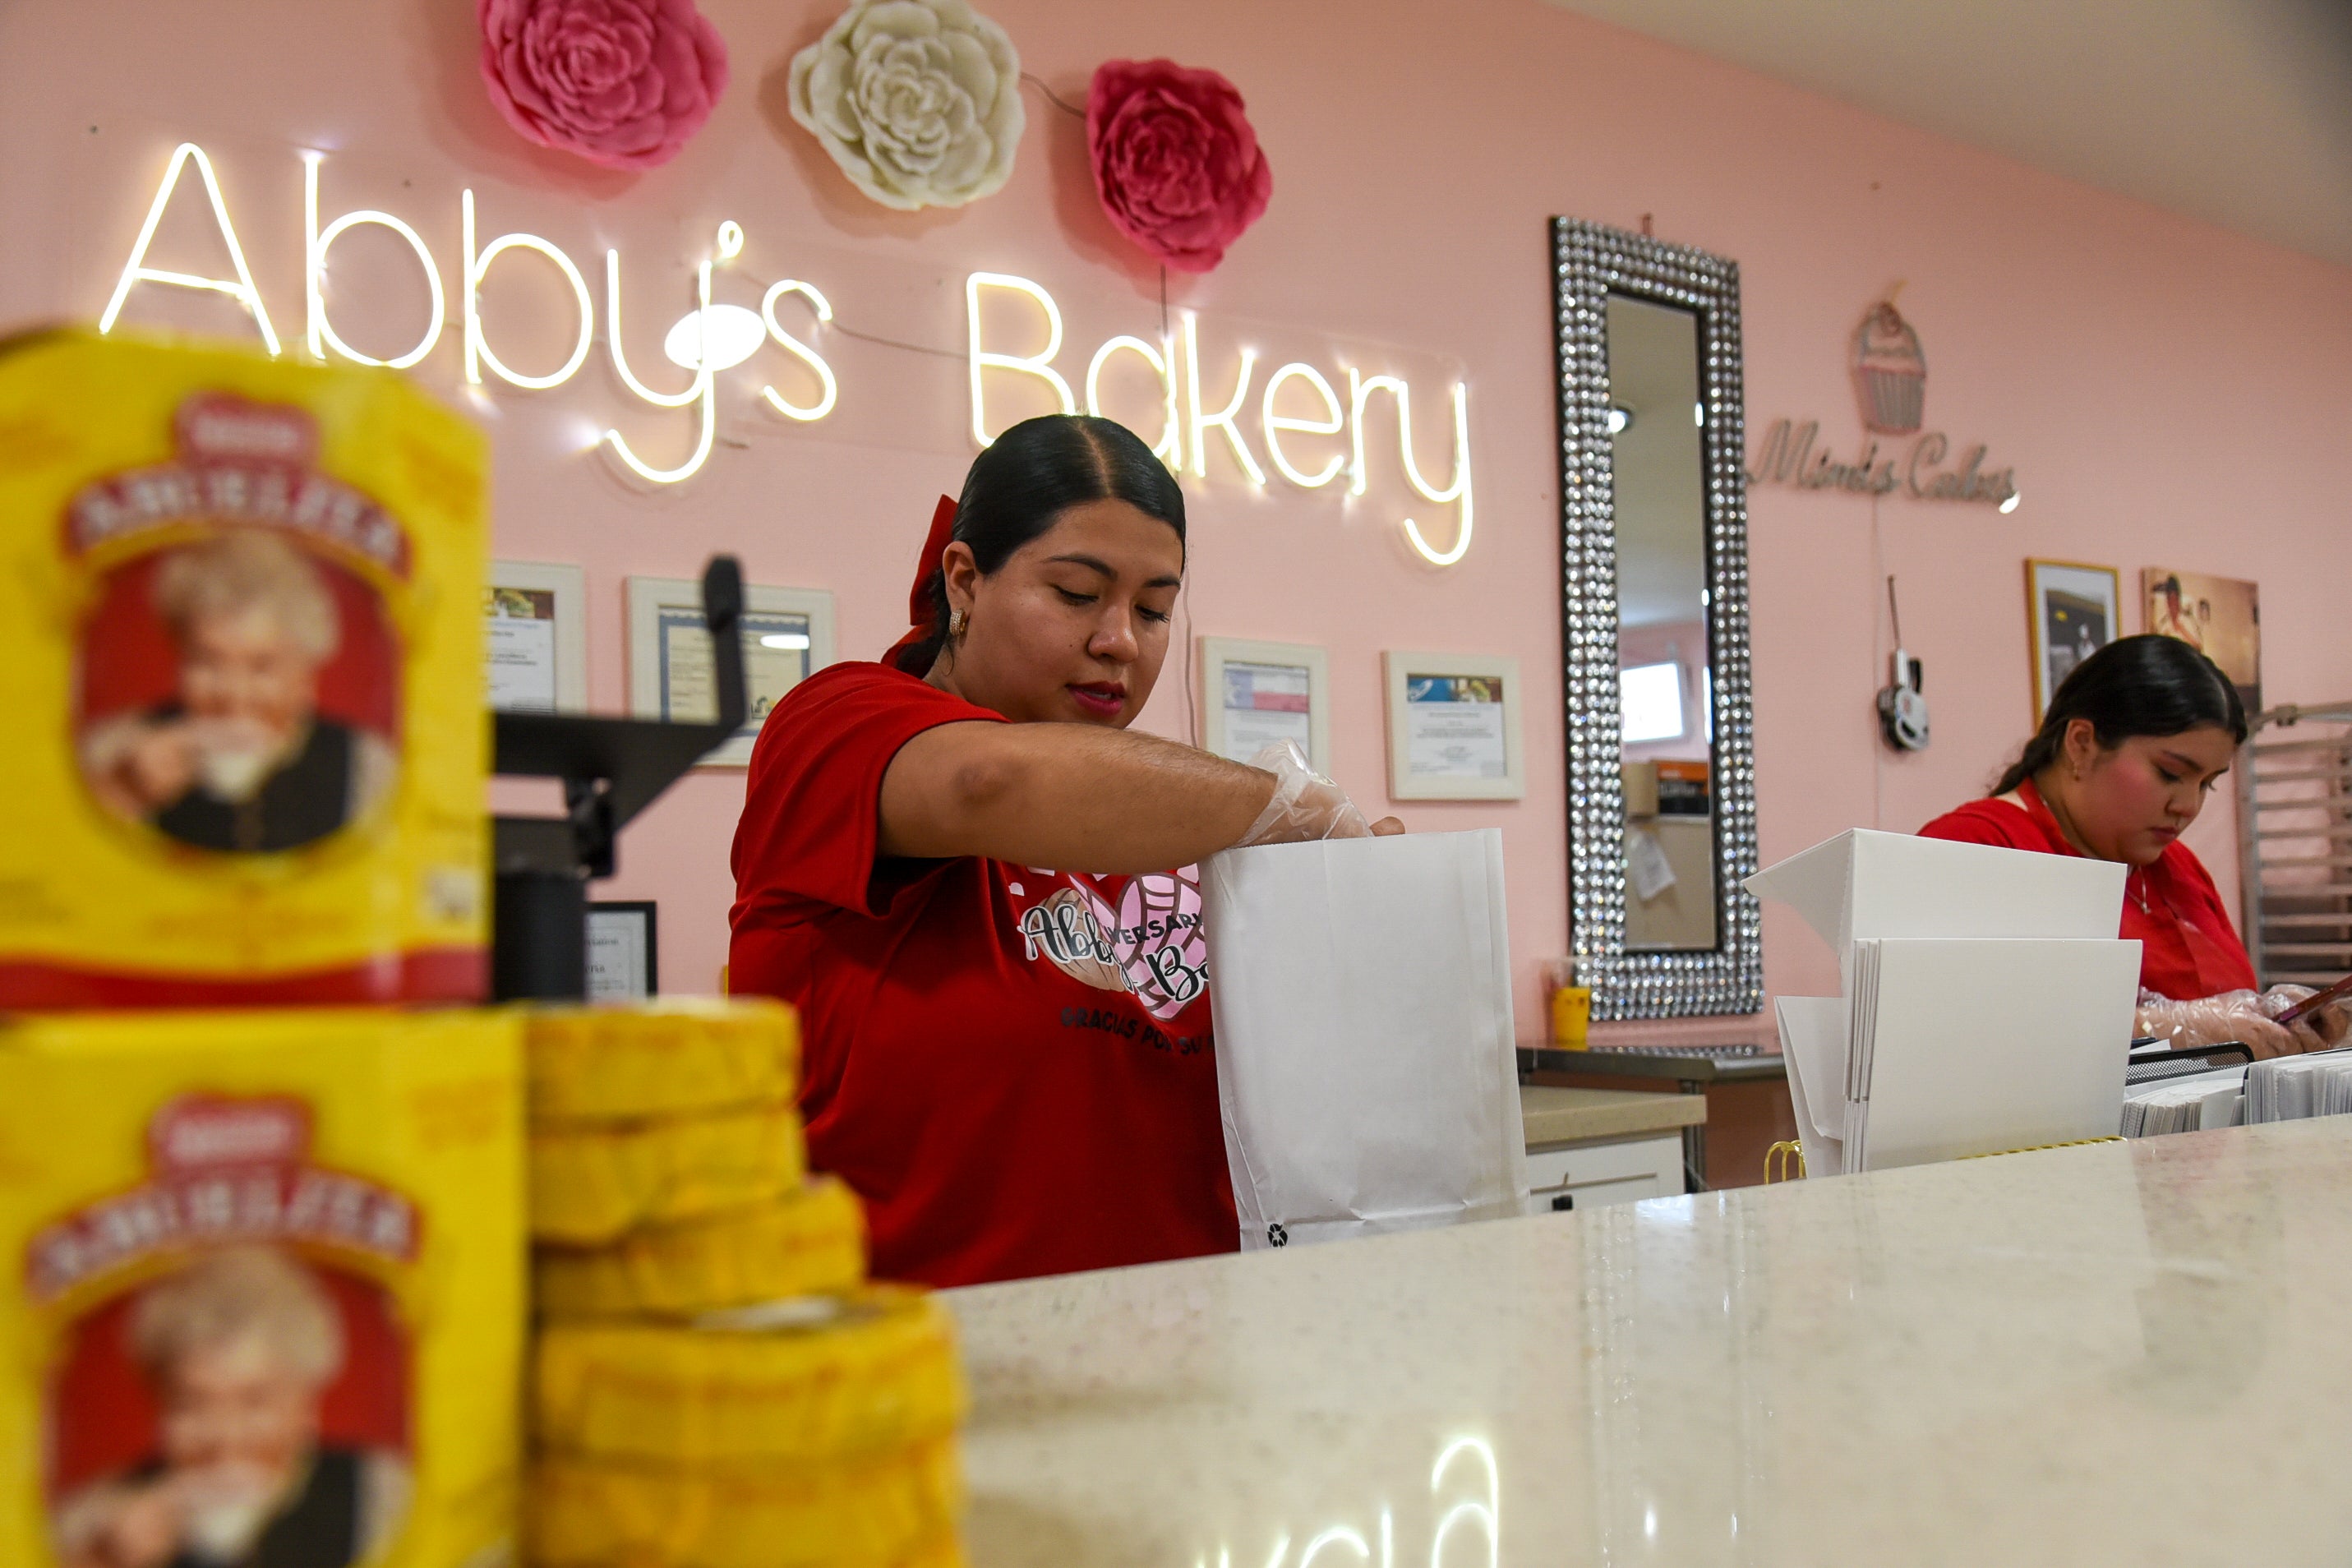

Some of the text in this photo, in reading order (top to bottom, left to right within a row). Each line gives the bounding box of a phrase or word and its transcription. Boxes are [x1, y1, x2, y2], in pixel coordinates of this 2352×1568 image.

[99, 142, 1473, 565] Abby's Bakery
[1061, 1007, 1138, 1040] GRACIAS
